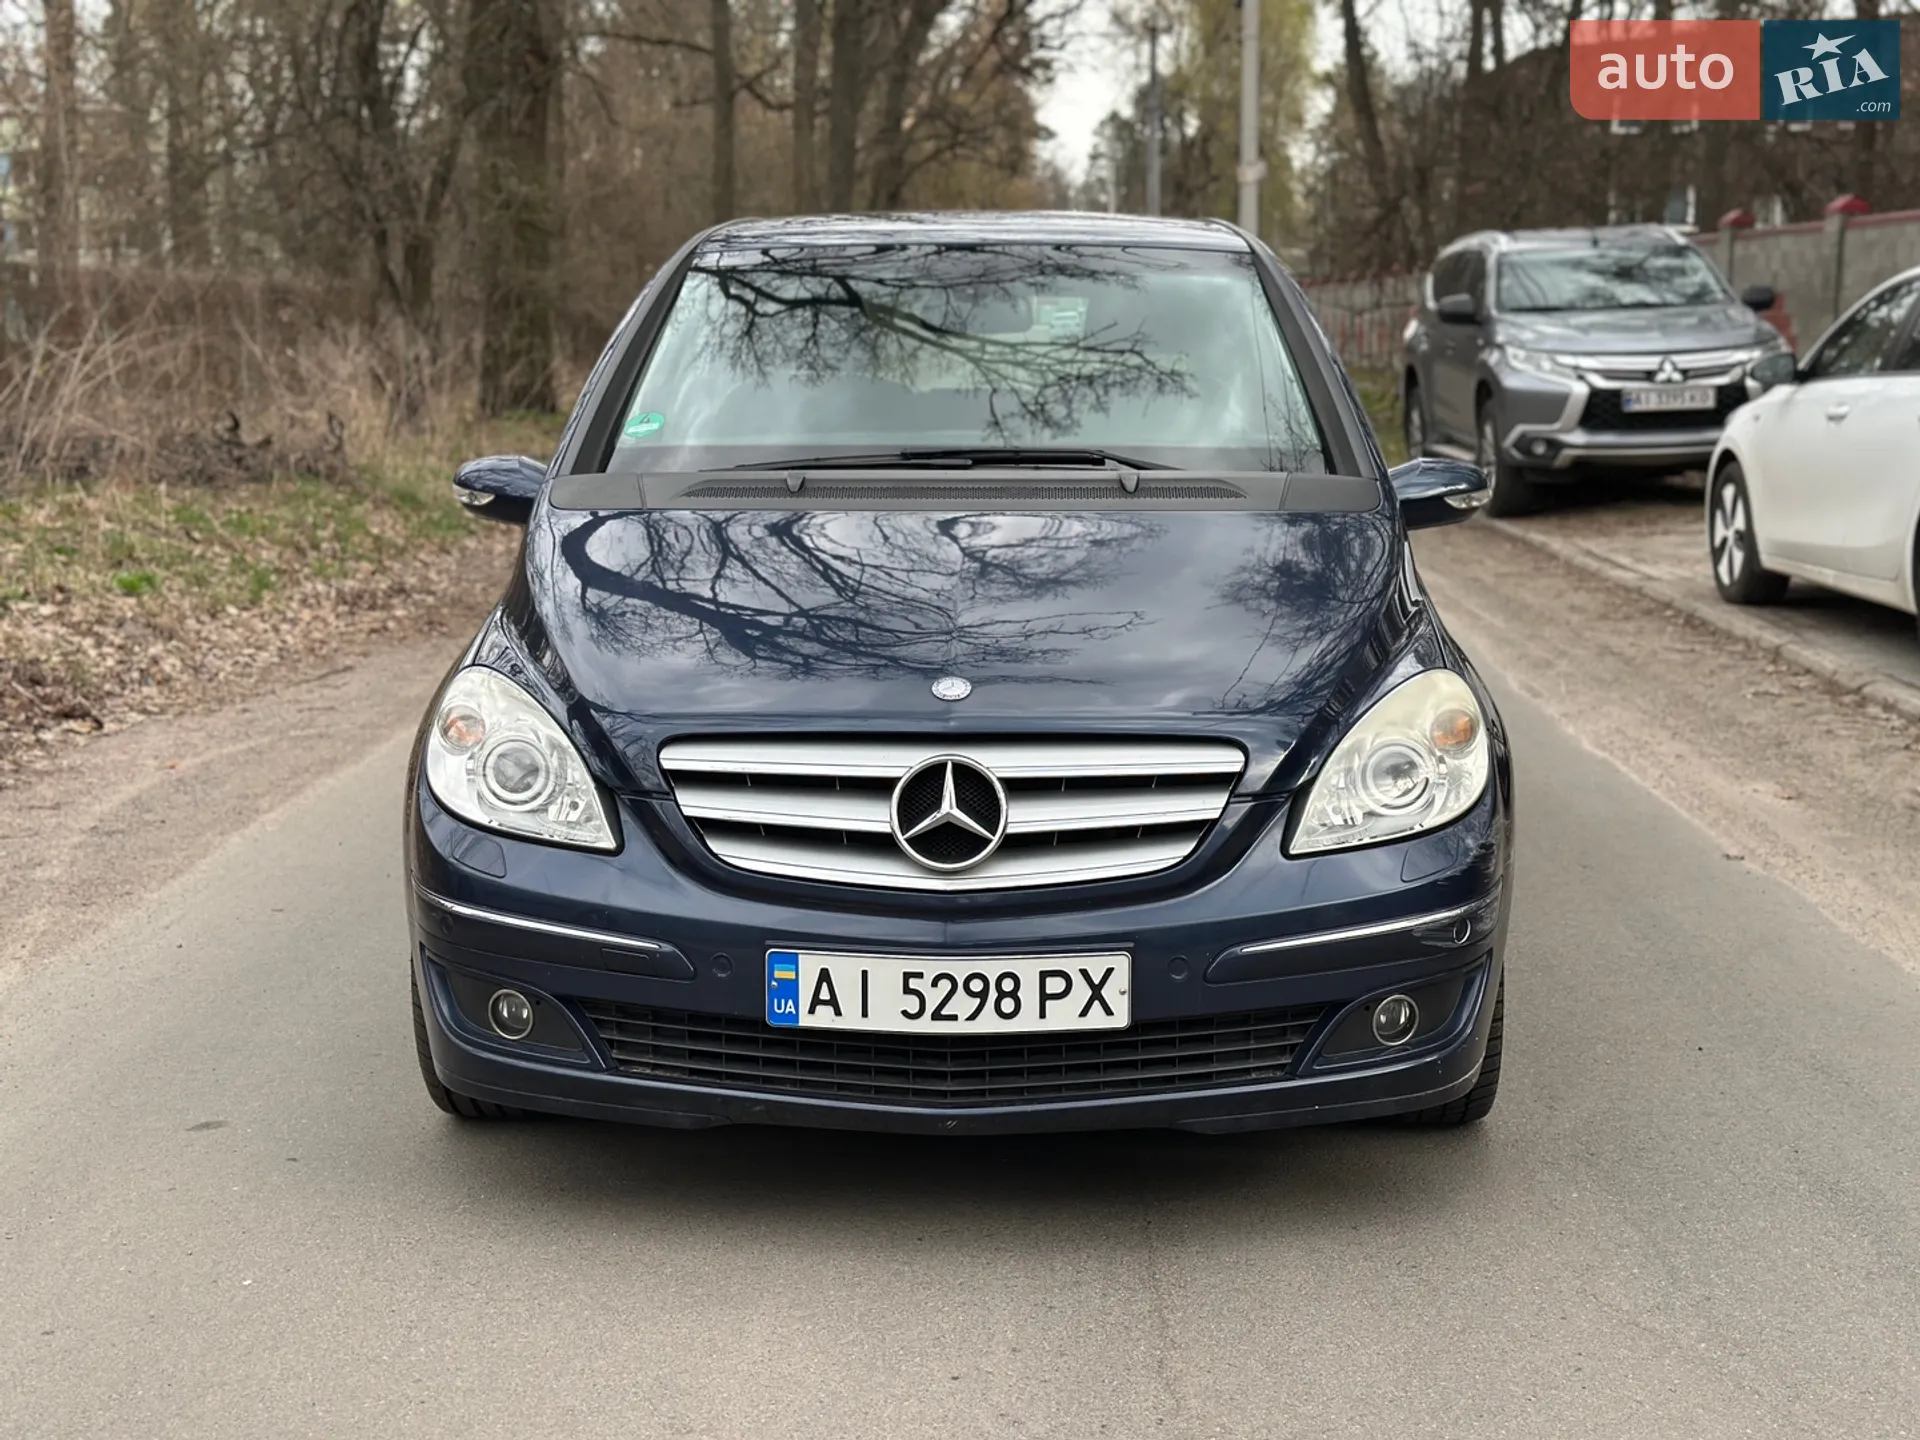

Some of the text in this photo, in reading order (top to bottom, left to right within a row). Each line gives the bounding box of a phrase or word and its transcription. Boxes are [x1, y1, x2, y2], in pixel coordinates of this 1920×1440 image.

[773, 998, 797, 1016] UA
[807, 966, 1116, 1022] AI 5298 PX
